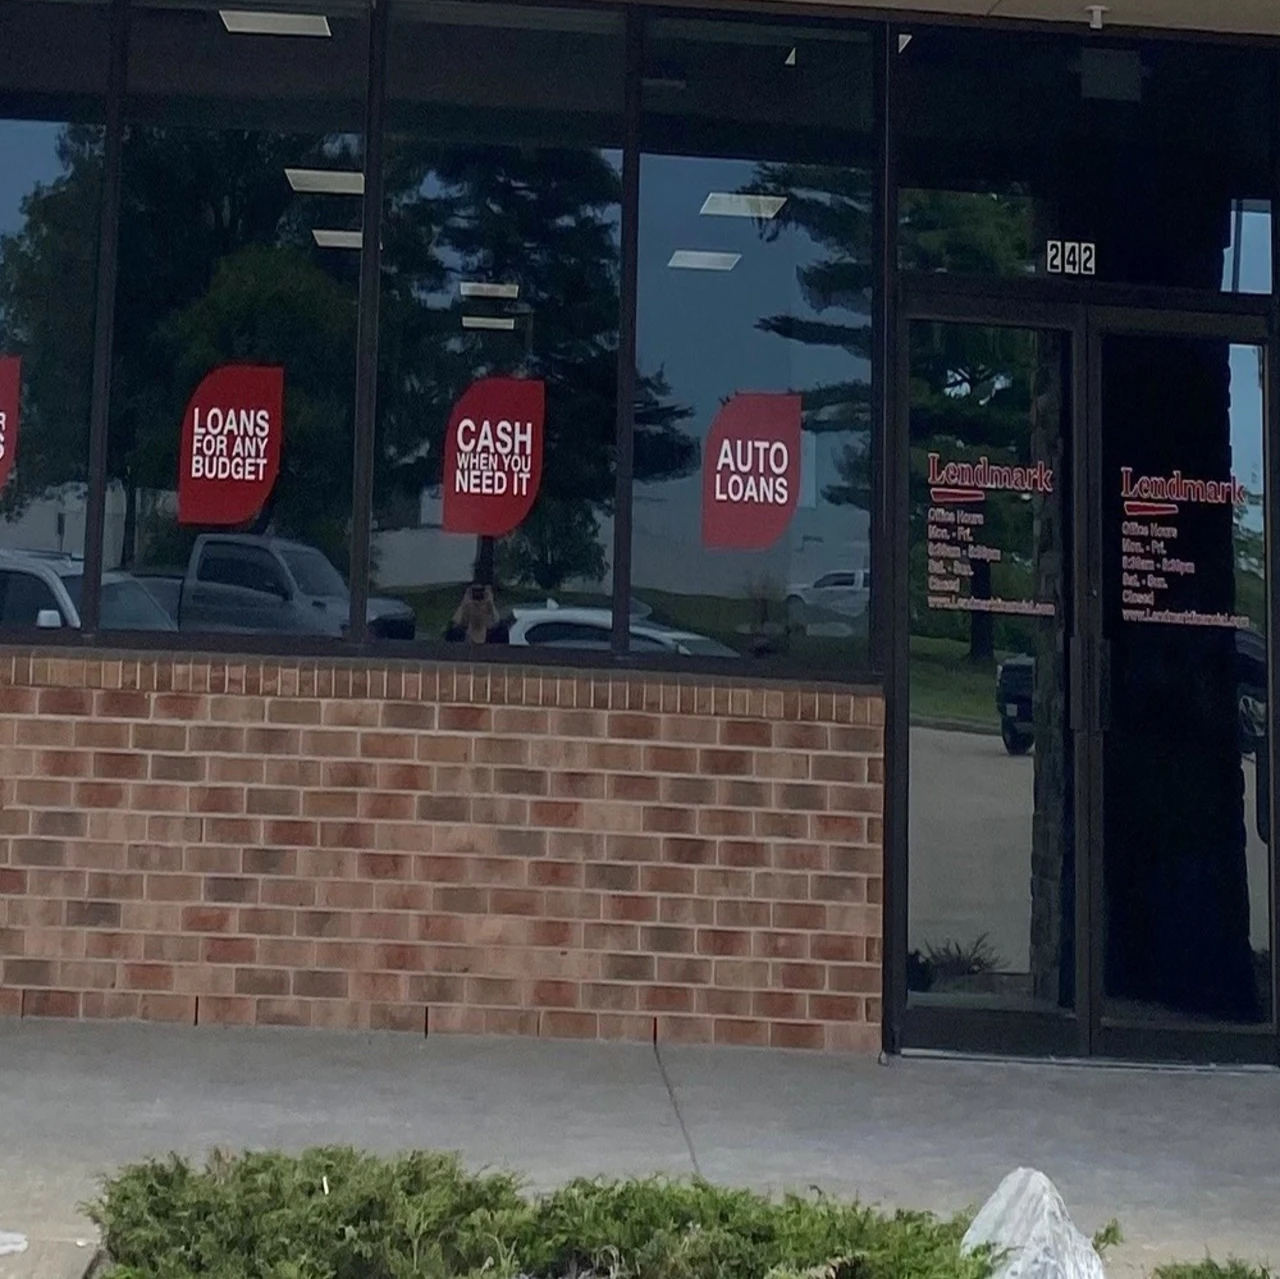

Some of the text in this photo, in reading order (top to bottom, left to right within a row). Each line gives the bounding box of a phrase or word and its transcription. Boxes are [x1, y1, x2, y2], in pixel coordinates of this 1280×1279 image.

[1048, 241, 1095, 274] 242
[194, 408, 269, 437] LOANS
[456, 418, 532, 454] CASH
[192, 435, 268, 457] FOR ANY
[717, 439, 789, 475] AUTO
[191, 457, 267, 481] BUDGET
[456, 452, 531, 473] WHEN YOU
[927, 452, 1053, 493] Lendmark
[455, 471, 531, 496] NEED IT
[715, 474, 789, 504] LOANS
[1121, 466, 1247, 505] Lendmark
